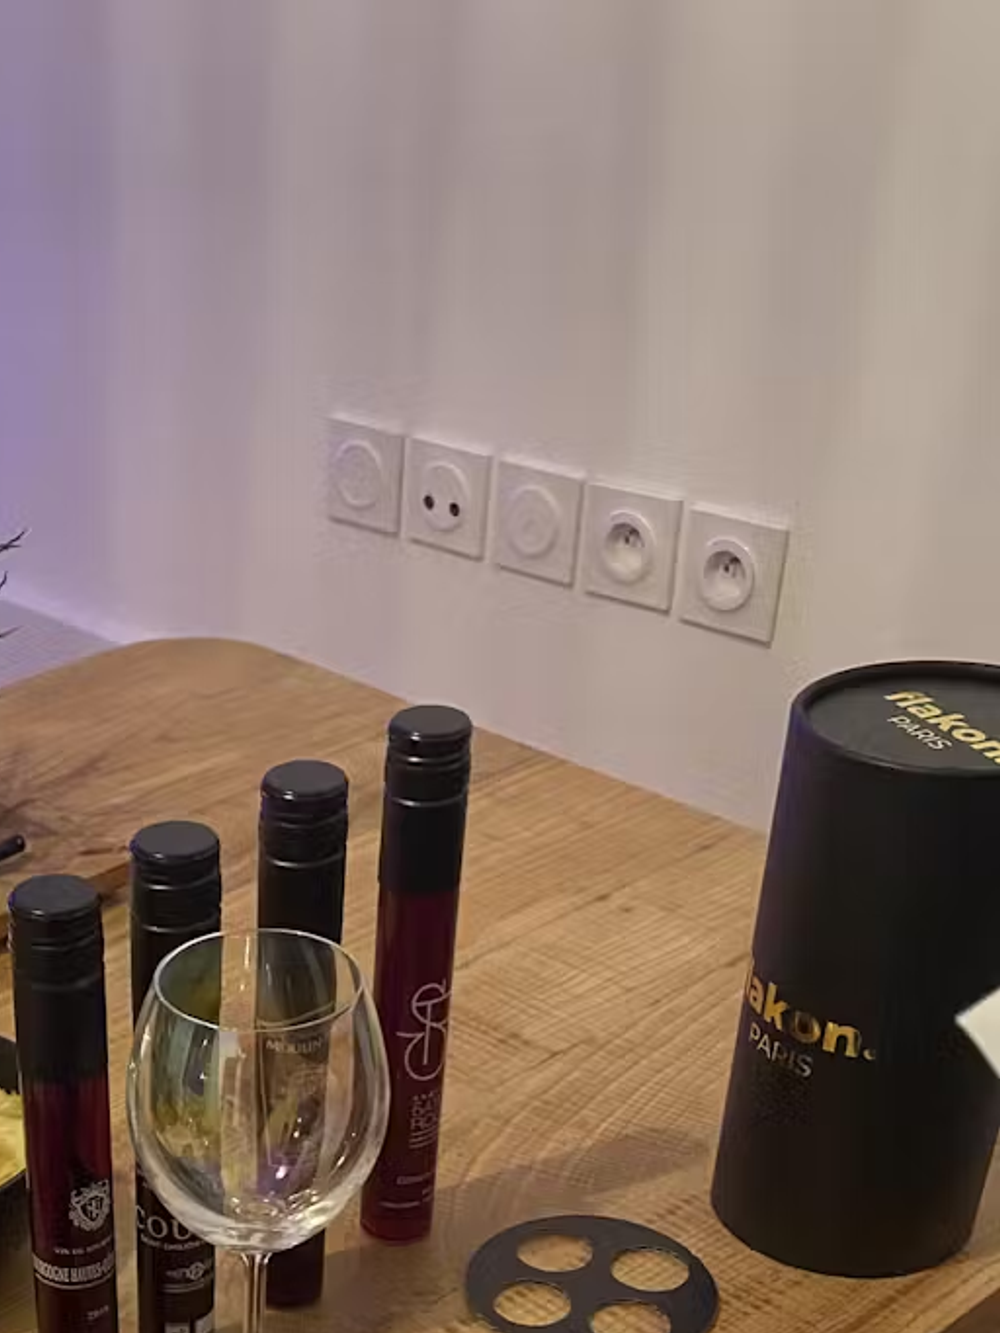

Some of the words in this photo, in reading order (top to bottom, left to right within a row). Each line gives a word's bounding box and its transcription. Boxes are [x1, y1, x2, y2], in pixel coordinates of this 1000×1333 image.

[887, 715, 953, 750] PARIS
[749, 1021, 813, 1077] PARIS
[136, 1205, 191, 1240] COU
